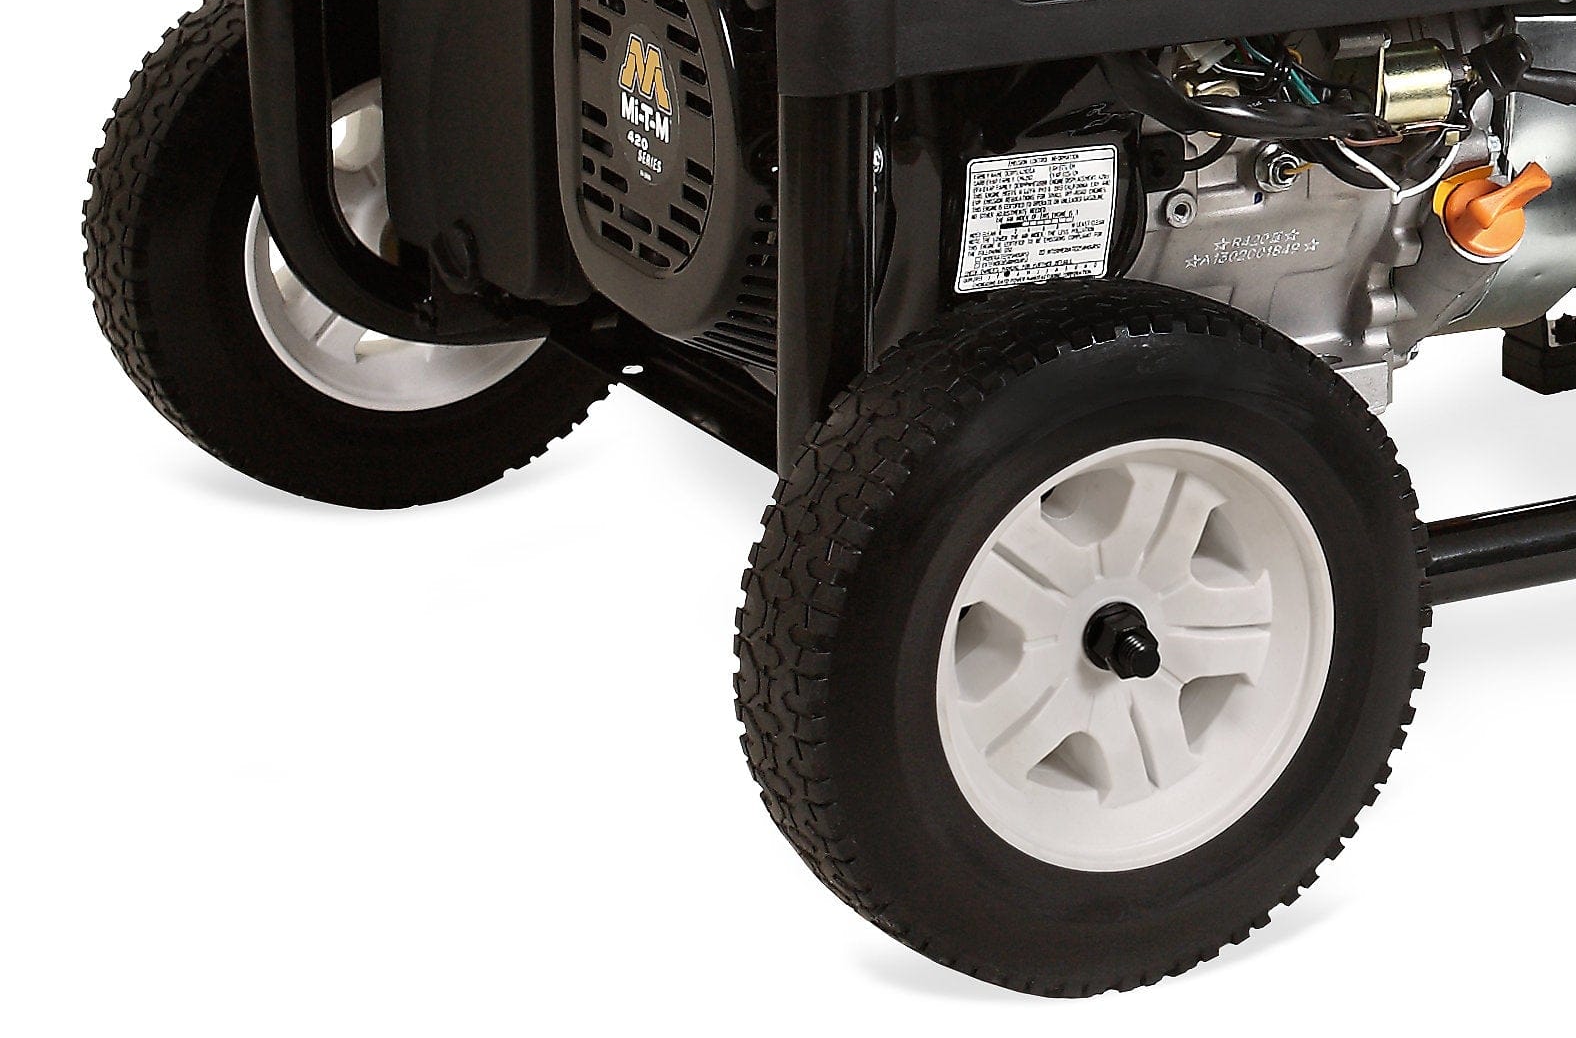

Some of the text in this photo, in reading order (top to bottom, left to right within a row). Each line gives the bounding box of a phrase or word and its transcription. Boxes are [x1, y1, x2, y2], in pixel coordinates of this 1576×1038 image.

[621, 91, 669, 143] Mi-T-M
[627, 130, 649, 150] 420
[637, 149, 662, 173] SERIES
